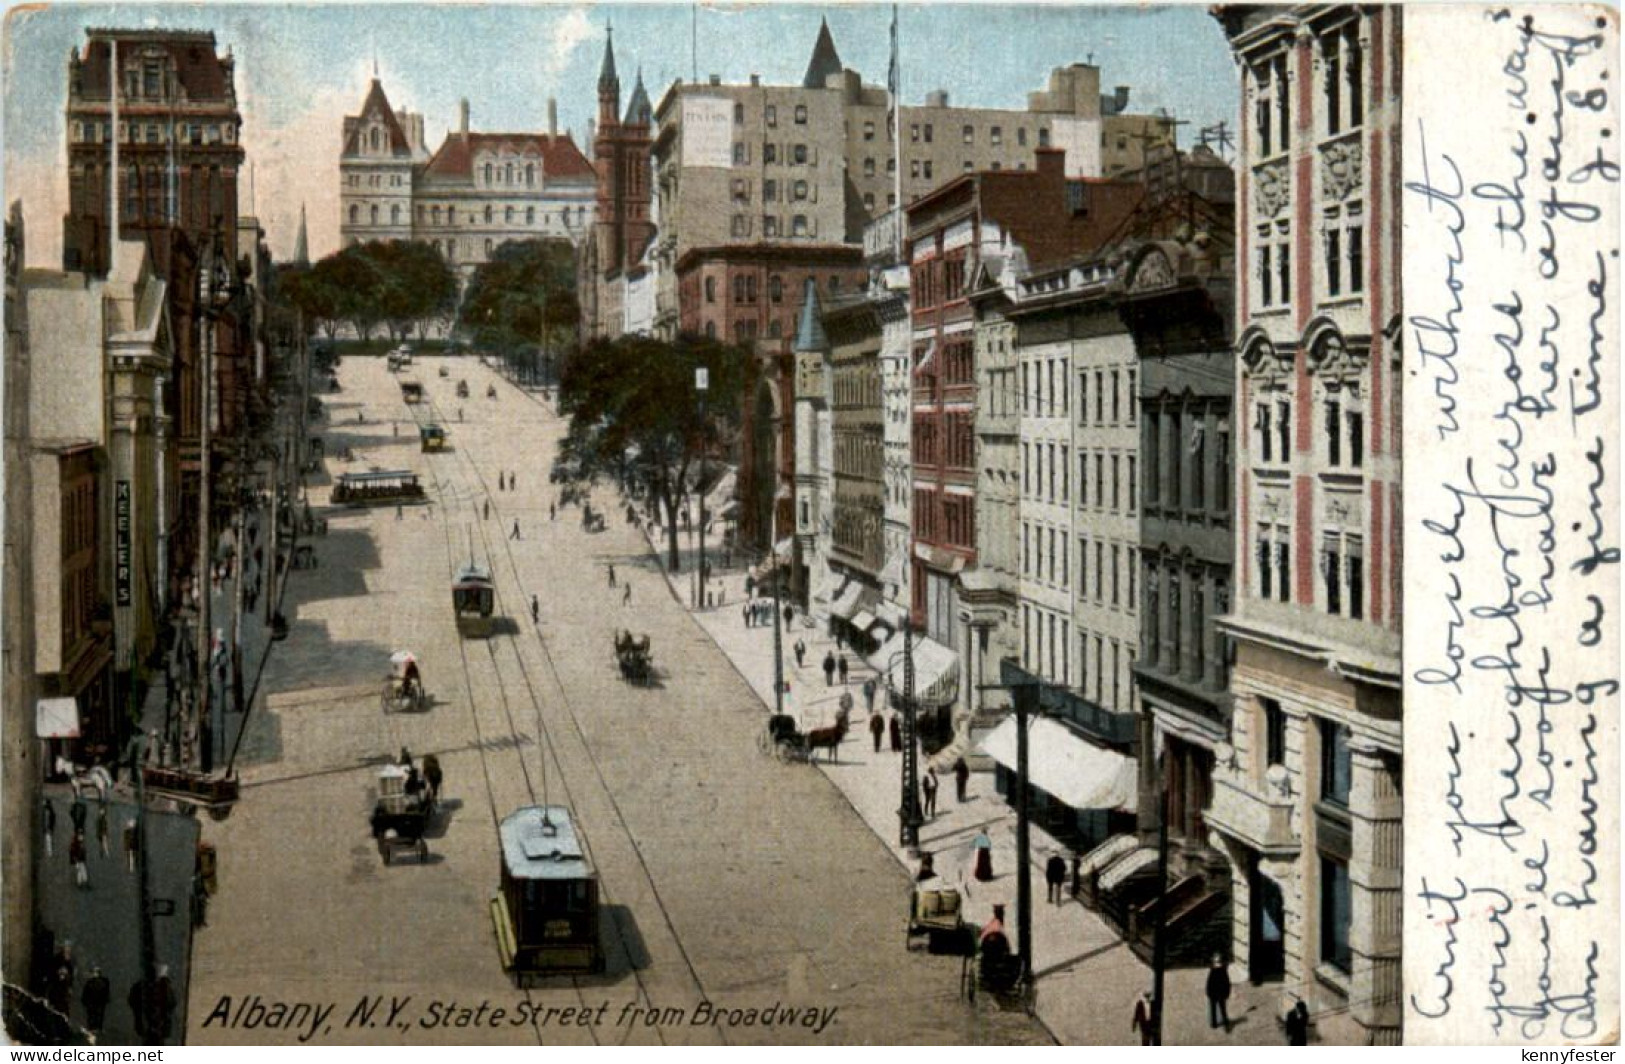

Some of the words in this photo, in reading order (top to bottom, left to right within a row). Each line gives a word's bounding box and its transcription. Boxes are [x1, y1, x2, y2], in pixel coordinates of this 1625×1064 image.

[1470, 129, 1528, 253] the
[1405, 117, 1465, 441] without
[1491, 290, 1523, 490] across
[1516, 303, 1558, 419] her
[1518, 452, 1554, 612] have
[1568, 437, 1621, 576] fine
[1467, 504, 1571, 853] neighbor
[1576, 594, 1604, 647] a
[1444, 721, 1526, 858] you
[1551, 678, 1620, 909] having
[1470, 888, 1545, 1036] your
